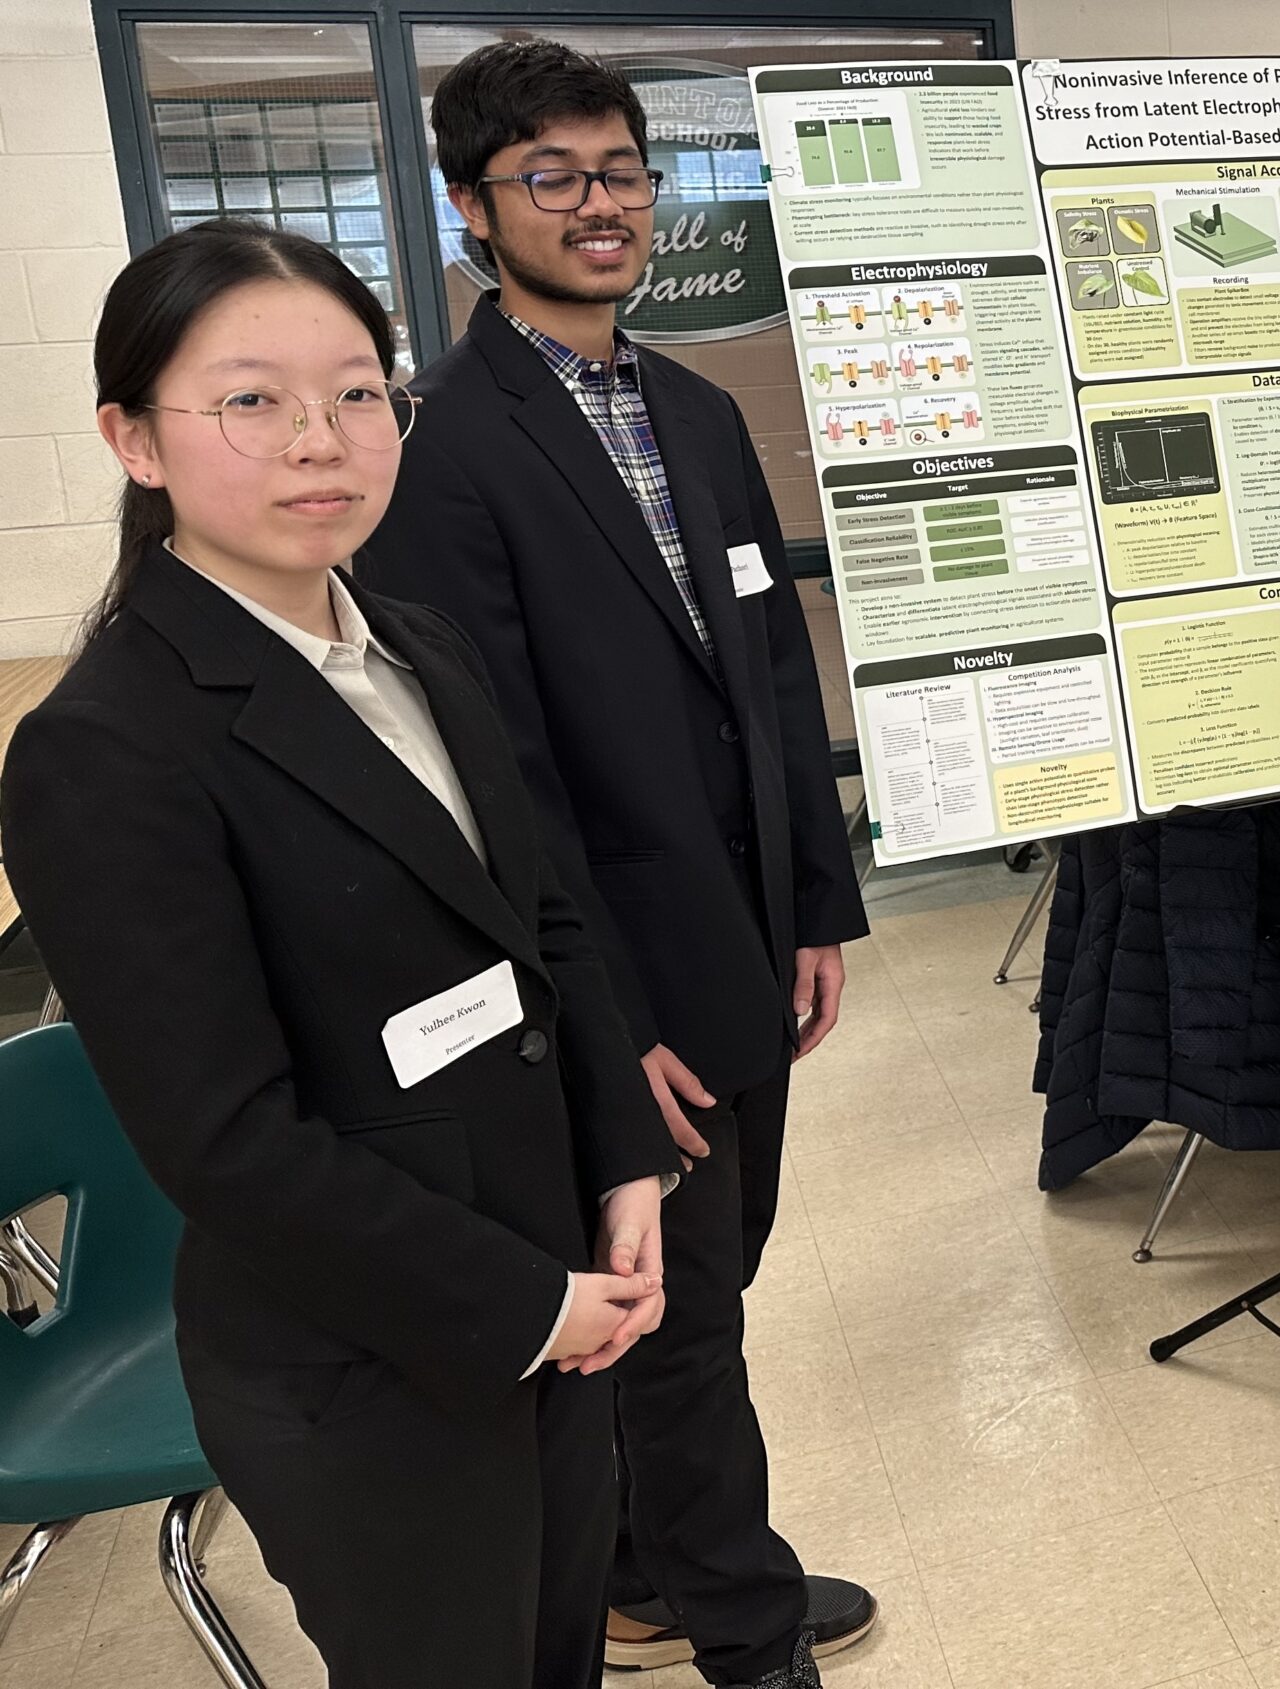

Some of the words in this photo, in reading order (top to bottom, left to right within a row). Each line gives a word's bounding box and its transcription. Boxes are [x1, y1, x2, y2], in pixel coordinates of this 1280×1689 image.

[841, 64, 933, 85] Background
[1052, 71, 1162, 88] Noninvasive
[1168, 69, 1247, 84] Inference
[1253, 67, 1268, 83] of
[1036, 100, 1090, 120] Stress
[1095, 102, 1138, 118] from
[1144, 101, 1198, 116] Latent
[646, 121, 739, 157] SCHOOL
[1086, 133, 1143, 149] Action
[1148, 129, 1280, 146] Potential-Based
[1216, 164, 1256, 180] Signal
[1176, 187, 1217, 195] Mechanical
[651, 211, 710, 256] all
[720, 219, 748, 253] of
[851, 260, 988, 281] Electrophysiology
[1212, 276, 1248, 284] Recording
[912, 457, 994, 475] Objectives
[856, 493, 886, 501] Objective
[1114, 520, 1148, 529] (Waveform)
[1174, 515, 1197, 523] (Feature
[1198, 512, 1216, 520] Space)
[953, 651, 1012, 670] Novelty
[1008, 670, 1051, 681] Competition
[1053, 666, 1080, 674] Analysis
[886, 689, 922, 698] Literature
[1040, 764, 1066, 772] Novelty
[419, 1013, 456, 1037] Yulhee
[456, 999, 487, 1019] Kwon
[445, 1034, 476, 1056] Presenter
